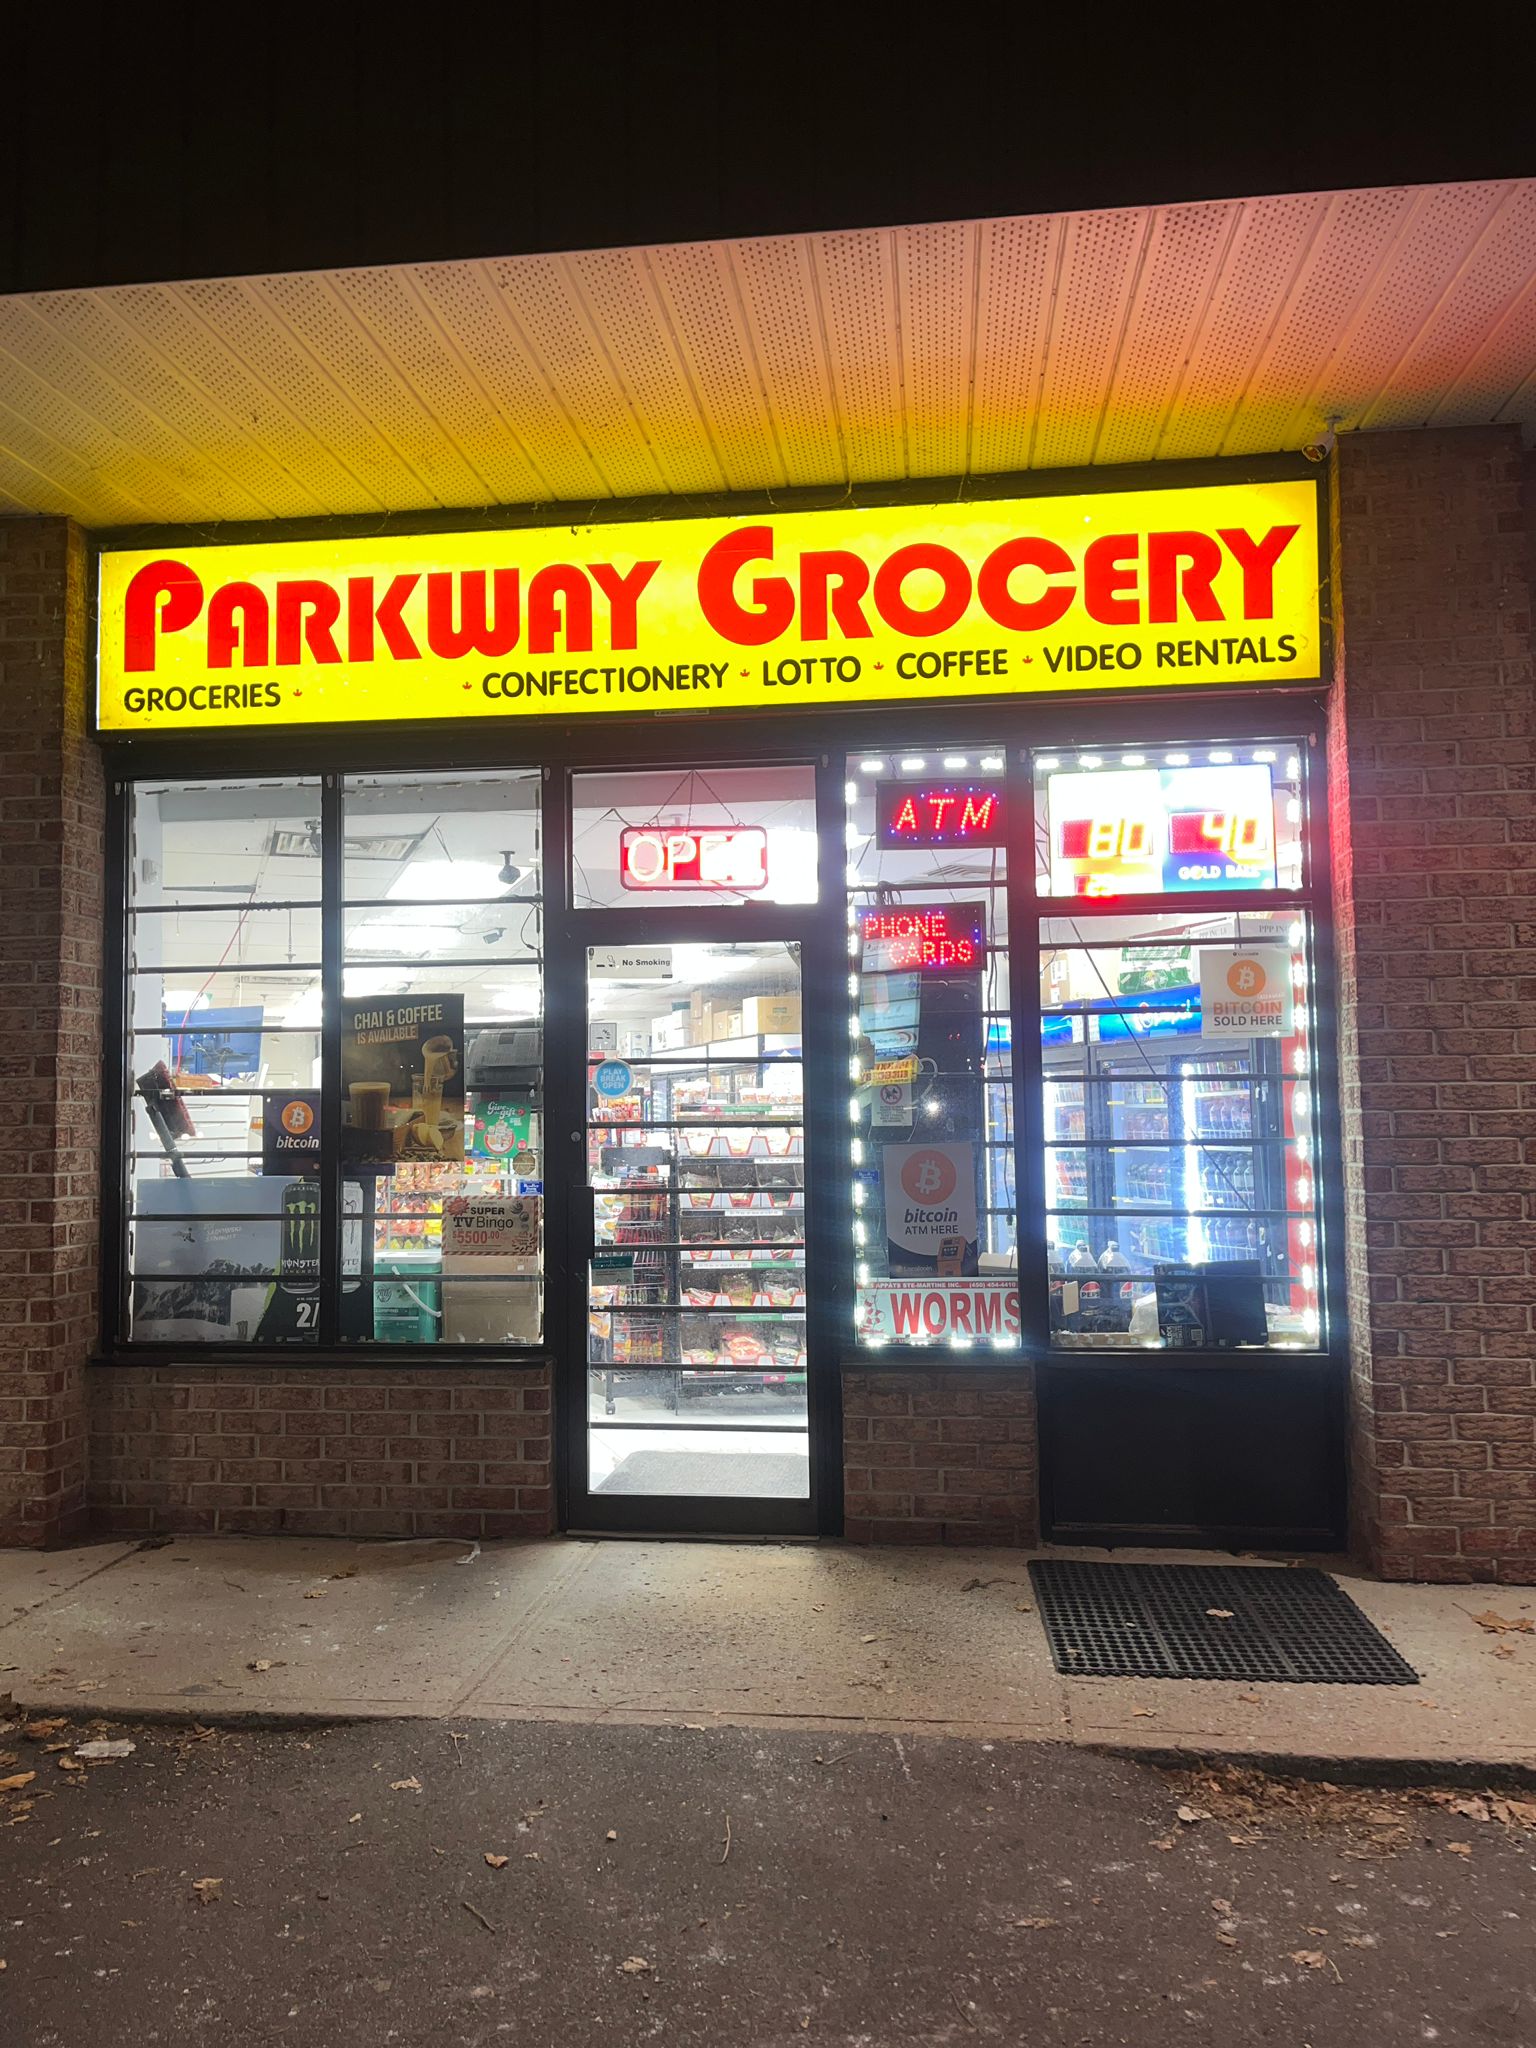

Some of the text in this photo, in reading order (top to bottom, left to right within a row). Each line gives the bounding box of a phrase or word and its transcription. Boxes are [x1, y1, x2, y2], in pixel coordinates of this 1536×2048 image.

[124, 525, 1301, 672] PARKWAY GROCERY
[124, 634, 1298, 713] GROCERIES CONFECTIONERY LOTTO COFFEE VIDEO RENTALS
[896, 797, 993, 830] ATM
[1203, 811, 1265, 852] 40
[1178, 864, 1222, 881] GOLD
[864, 914, 947, 939] PHONE
[888, 940, 972, 964] CARDS
[622, 958, 671, 968] No Smoking
[1213, 1001, 1282, 1016] BITCOIN
[354, 1004, 443, 1030] CHAI & COFFEE
[1213, 1015, 1283, 1027] SOLD HERE
[357, 1026, 417, 1044] IS AVAILABLE
[602, 1081, 625, 1089] OPEN
[276, 1134, 320, 1149] bitcoin
[470, 1206, 505, 1215] SUPER
[904, 1208, 958, 1224] bitcoin
[453, 1216, 514, 1231] TV Bingo
[904, 1225, 959, 1235] ATM HERE
[282, 1259, 320, 1268] MONSTE
[889, 1291, 1021, 1335] WORMS
